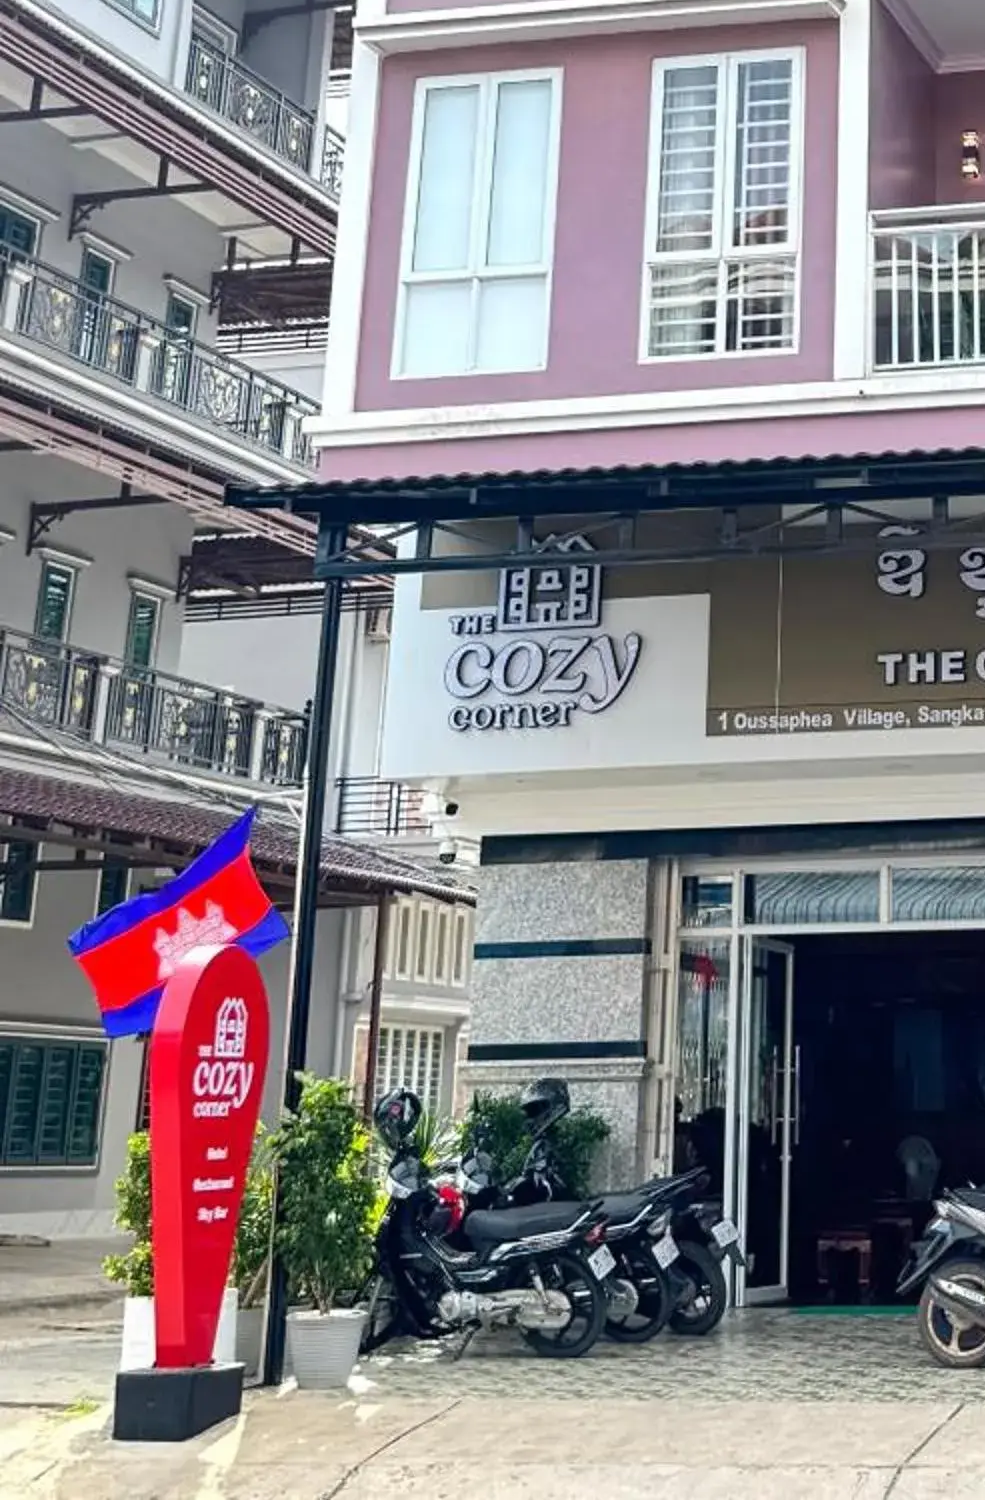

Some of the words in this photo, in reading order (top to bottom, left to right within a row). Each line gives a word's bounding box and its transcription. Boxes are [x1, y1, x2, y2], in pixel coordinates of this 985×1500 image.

[449, 614, 497, 636] THE
[878, 650, 965, 687] THE
[449, 699, 579, 732] corner
[719, 713, 729, 731] 1
[733, 710, 834, 733] Oussaphea
[843, 707, 913, 729] Village,
[193, 1101, 231, 1117] corner
